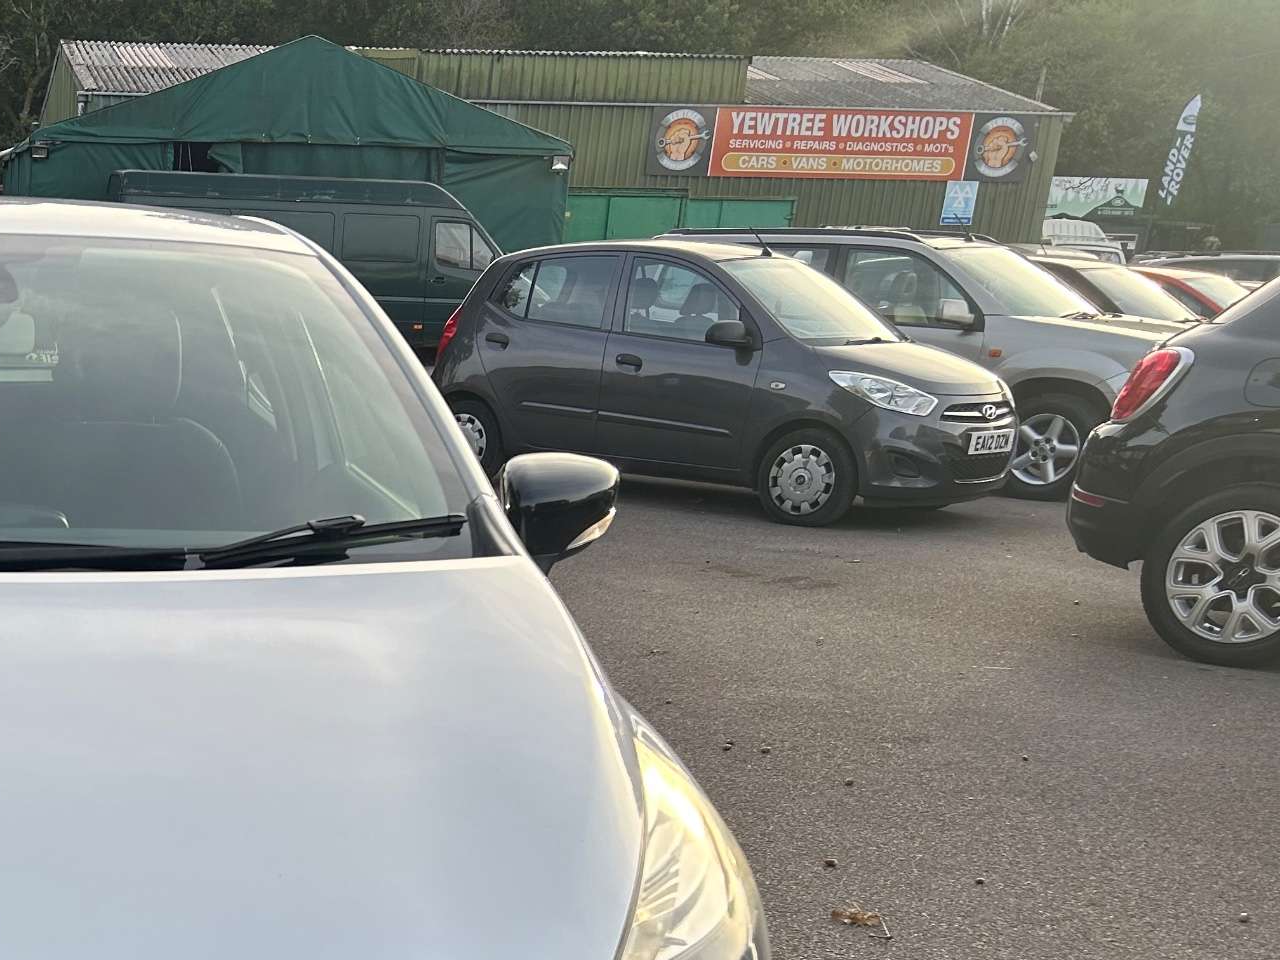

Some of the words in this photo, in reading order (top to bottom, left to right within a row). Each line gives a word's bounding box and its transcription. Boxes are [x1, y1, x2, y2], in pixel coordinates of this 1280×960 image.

[731, 112, 826, 136] YEWTREE
[832, 114, 960, 139] WORKSHOPS
[729, 139, 783, 149] SERVICING
[793, 141, 836, 150] REPAIRS
[846, 142, 914, 152] DIAGNOSTICS
[924, 144, 954, 153] MOT's
[739, 156, 776, 168] CARS
[791, 157, 827, 169] VANS
[841, 159, 942, 172] MOTORHOMES
